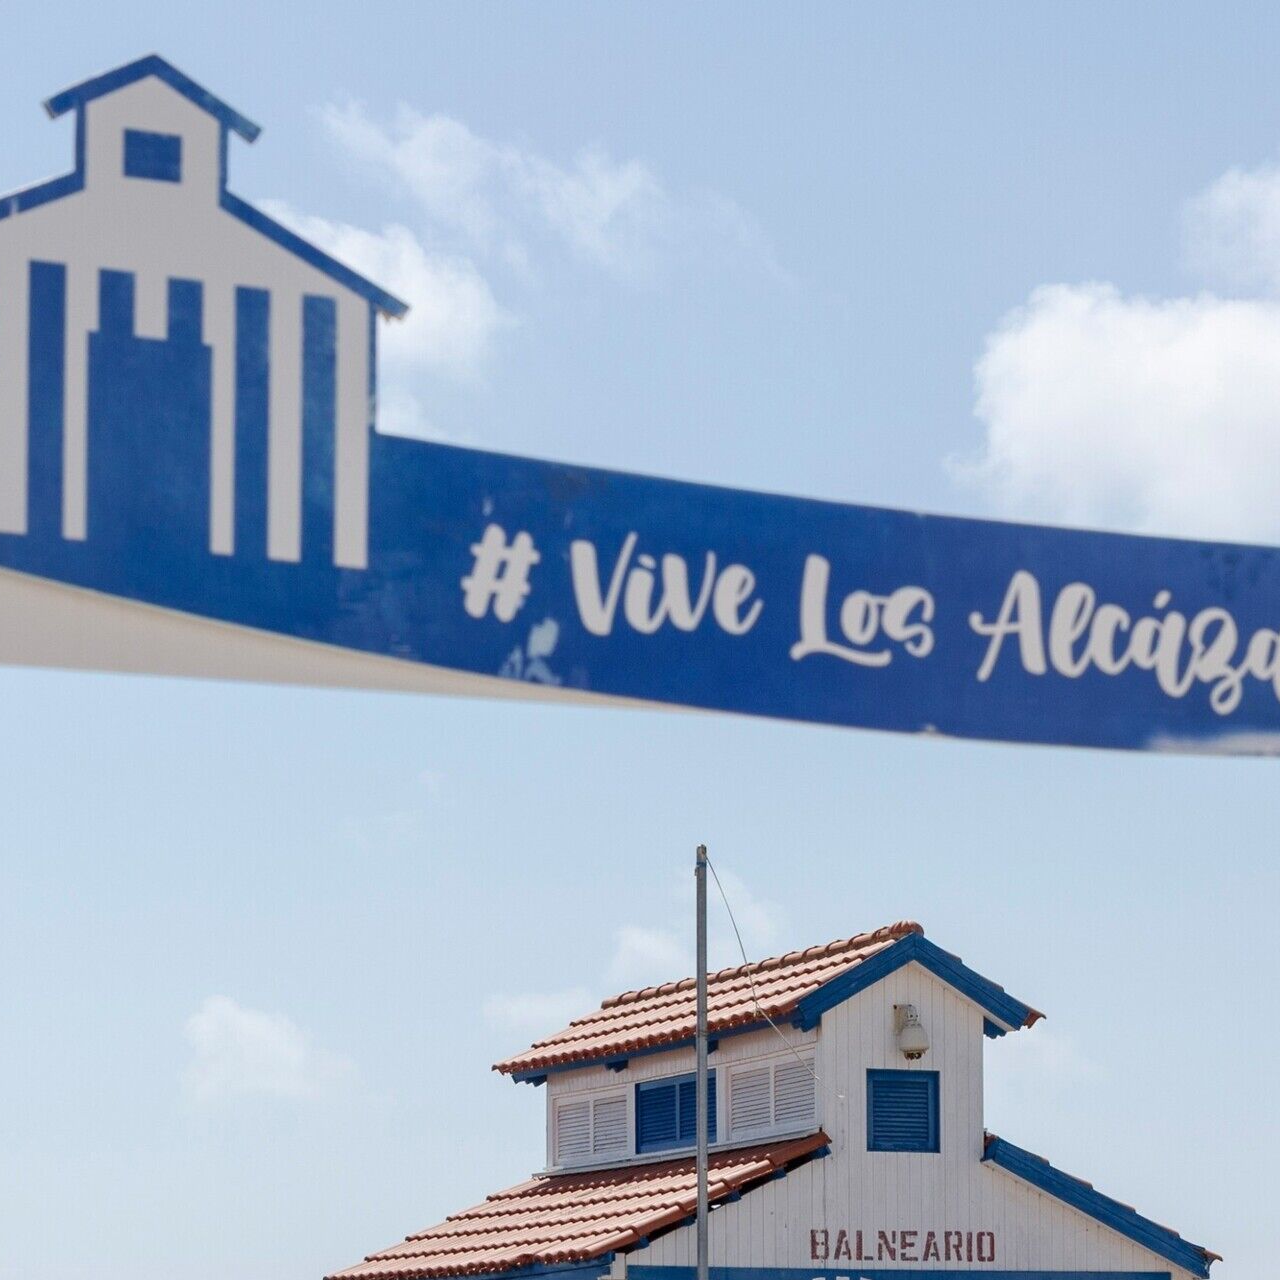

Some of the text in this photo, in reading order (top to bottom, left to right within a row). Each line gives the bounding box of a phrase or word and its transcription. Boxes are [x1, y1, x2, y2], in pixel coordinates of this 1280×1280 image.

[461, 524, 541, 623] #
[570, 531, 764, 636] Vive
[789, 554, 936, 667] Los
[810, 1229, 995, 1262] BALNEARIO
